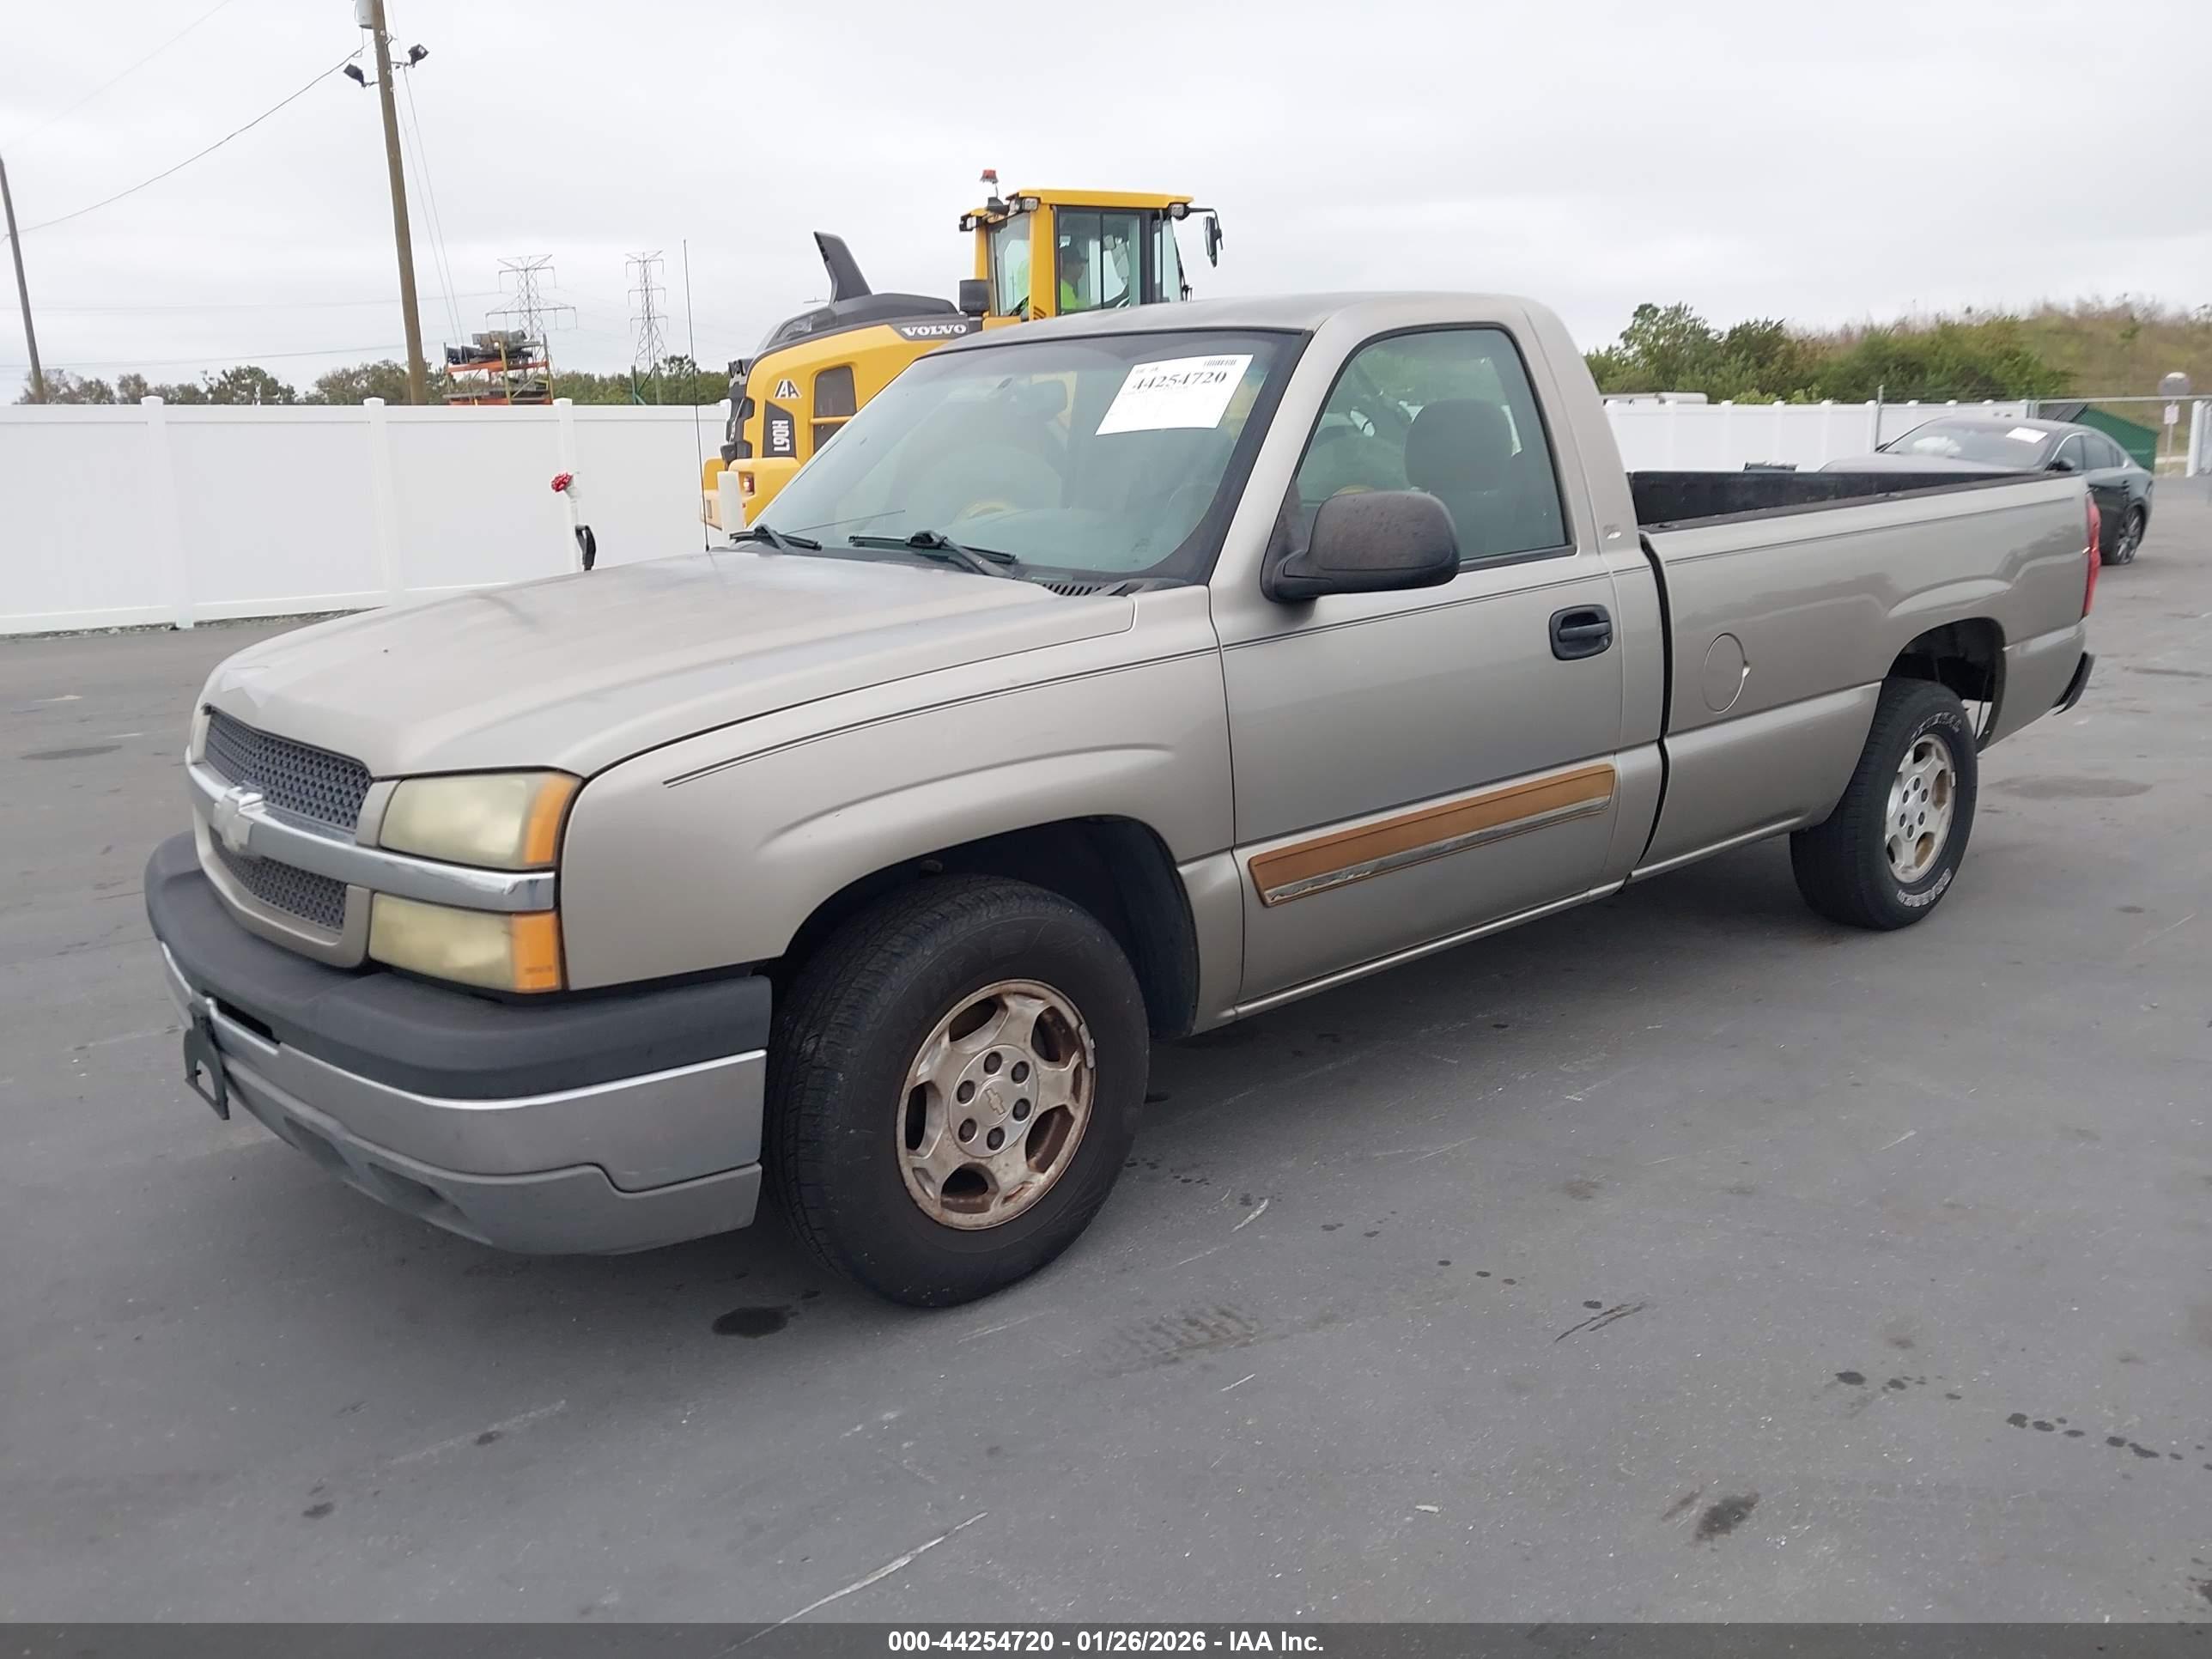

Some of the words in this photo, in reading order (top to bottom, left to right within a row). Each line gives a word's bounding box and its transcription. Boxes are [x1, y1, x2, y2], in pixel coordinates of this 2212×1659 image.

[902, 324, 967, 337] VOLVO
[1133, 371, 1227, 390] 44254720
[771, 419, 791, 452] L90H
